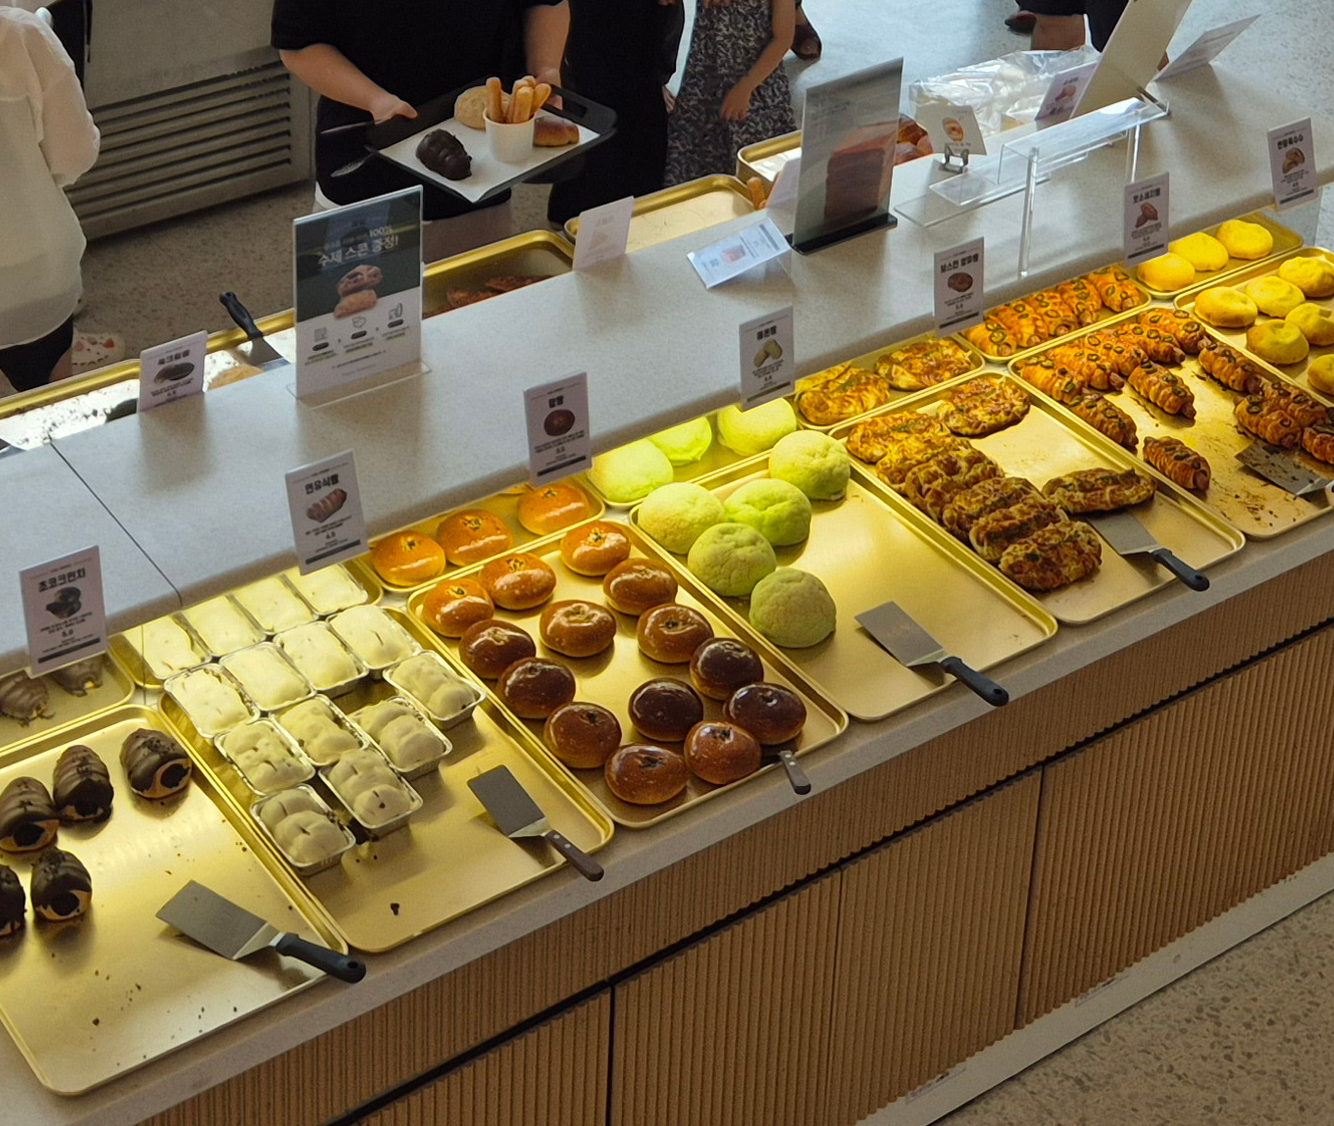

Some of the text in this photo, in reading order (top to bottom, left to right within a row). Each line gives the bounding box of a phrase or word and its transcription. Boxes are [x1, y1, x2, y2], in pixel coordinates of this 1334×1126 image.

[317, 250, 343, 268] 수제
[344, 242, 368, 261] 스콘
[371, 235, 400, 253] 증정!
[304, 473, 339, 495] 연유식빵
[38, 567, 86, 593] 초코크런치
